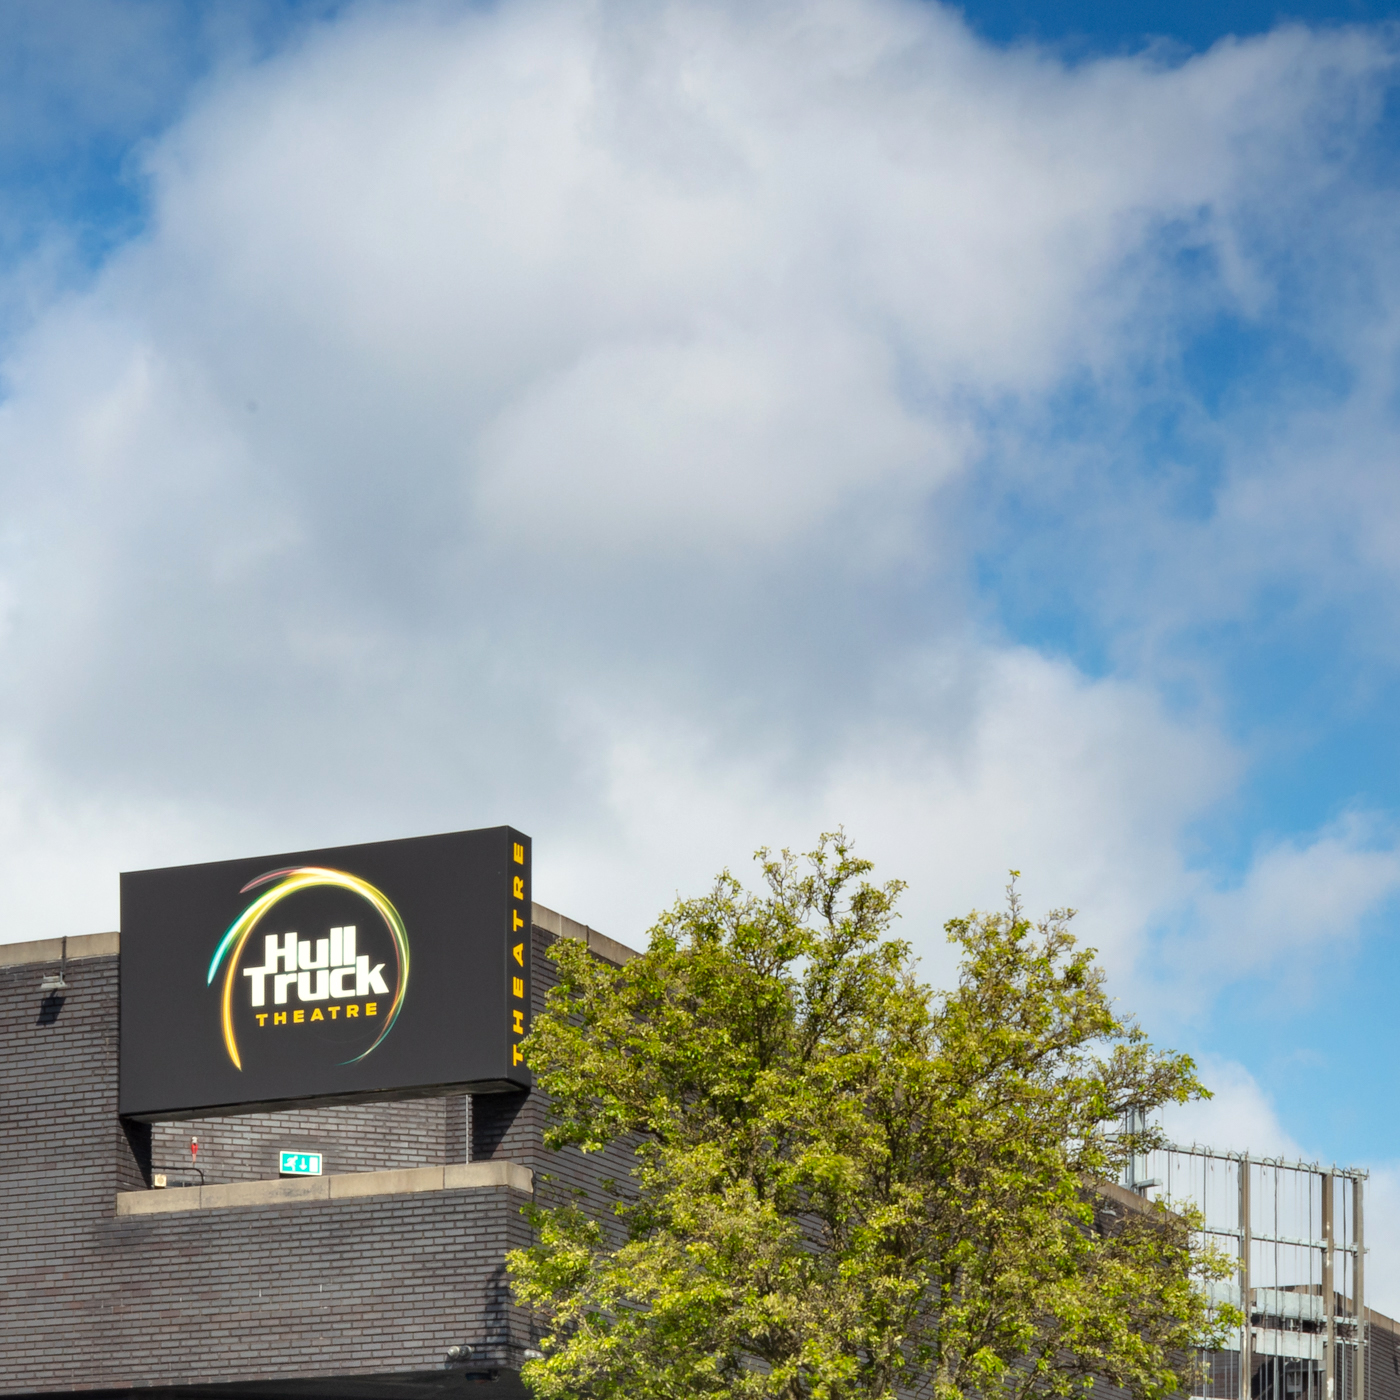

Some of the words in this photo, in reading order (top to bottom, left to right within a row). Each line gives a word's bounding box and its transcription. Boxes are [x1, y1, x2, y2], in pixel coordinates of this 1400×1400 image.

[264, 925, 357, 975] Hull
[513, 841, 525, 1067] THEATRE
[243, 955, 389, 1007] Truck
[256, 1002, 377, 1027] THEATRE
